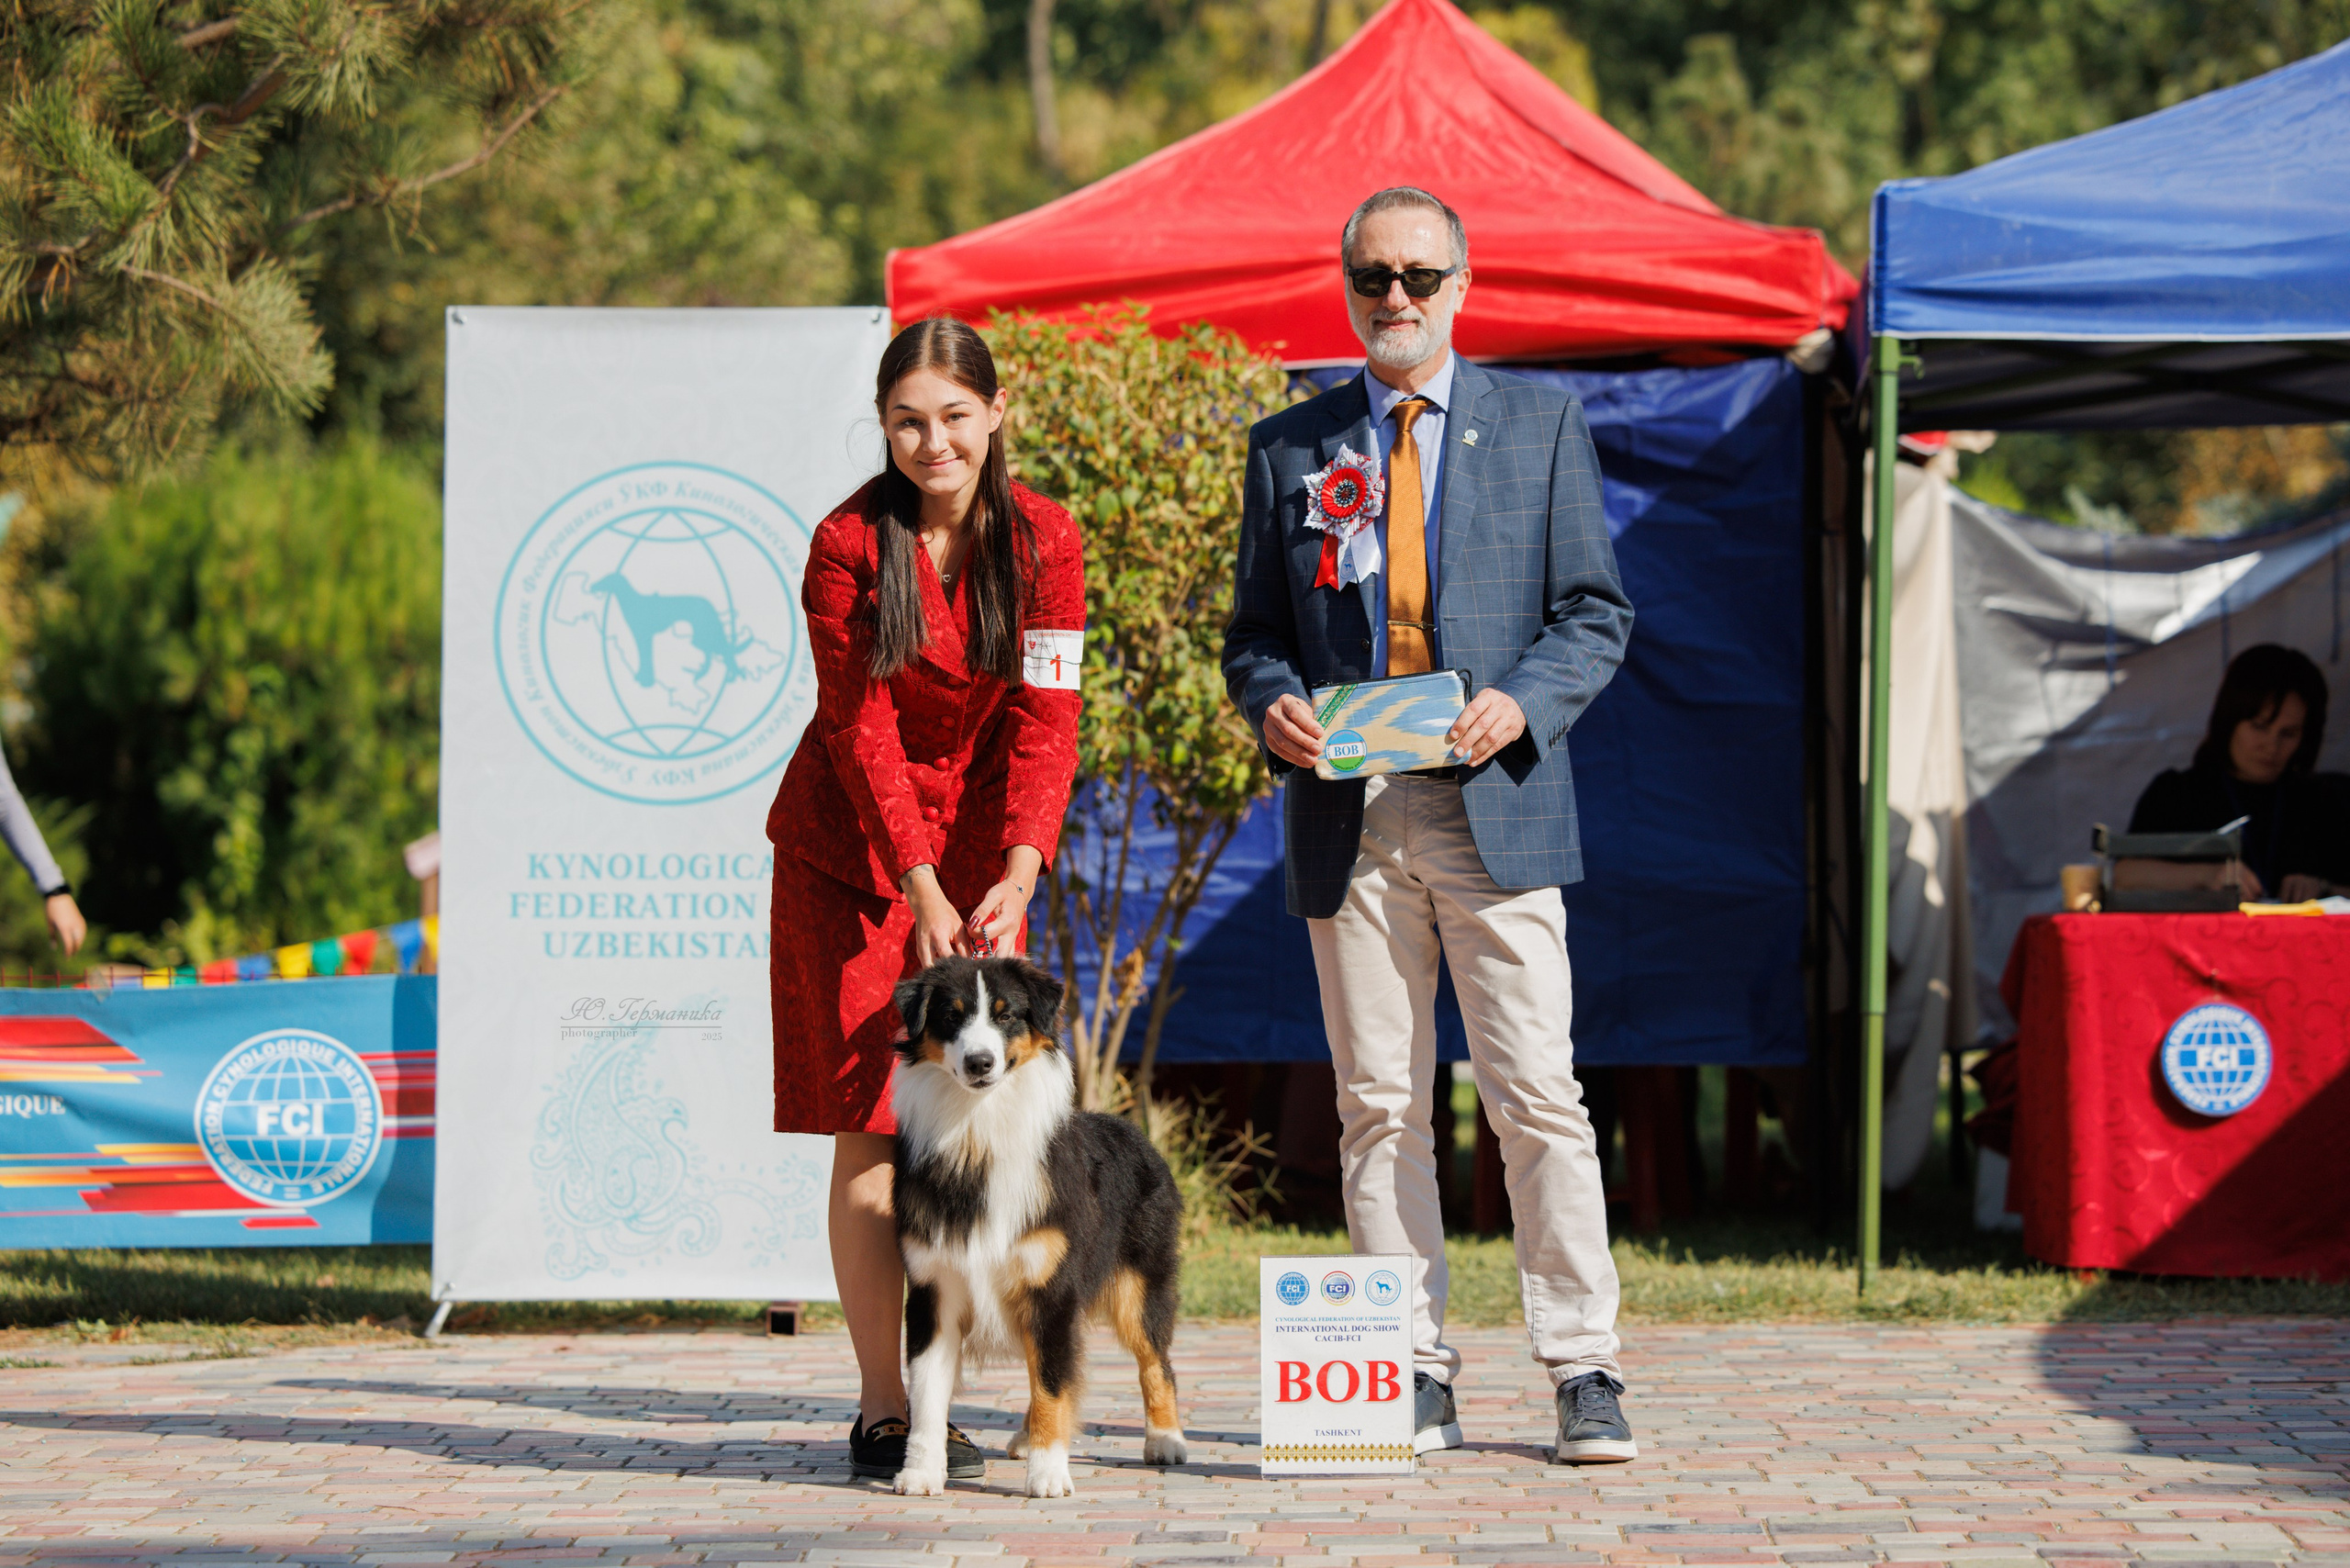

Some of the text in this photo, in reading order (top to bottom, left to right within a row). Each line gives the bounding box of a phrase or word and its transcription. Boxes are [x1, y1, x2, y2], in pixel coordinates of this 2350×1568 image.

[1049, 655, 1061, 681] 1
[1334, 745, 1359, 756] BOB
[509, 891, 757, 920] FEDERATION
[2197, 1047, 2240, 1070] FCI
[204, 1038, 374, 1196] FEDERATION CYNOLOGIQUE INTERNATIONALE
[256, 1103, 325, 1137] FCI
[1286, 1284, 1300, 1293] FCI
[1329, 1284, 1347, 1293] FCI
[1275, 1325, 1349, 1333] INTERNATIONAL
[1274, 1360, 1403, 1404] BOB
[1315, 1428, 1362, 1437] TASHKENT
